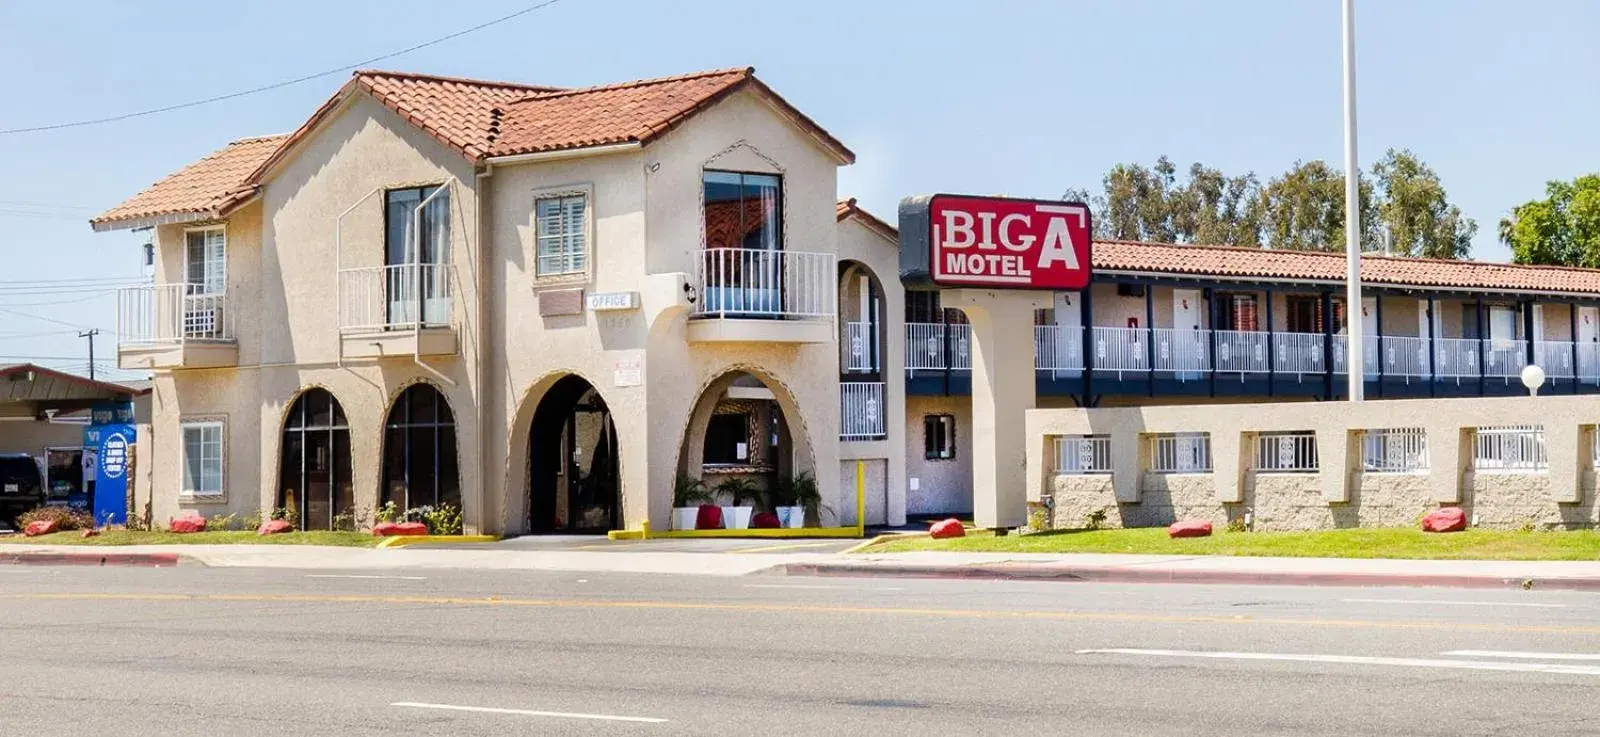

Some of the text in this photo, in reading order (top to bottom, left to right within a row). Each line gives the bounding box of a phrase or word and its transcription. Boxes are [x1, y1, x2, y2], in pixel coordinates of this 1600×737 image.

[941, 209, 1080, 270] BIG A
[946, 252, 1032, 276] MOTEL
[592, 295, 626, 307] OFFICE
